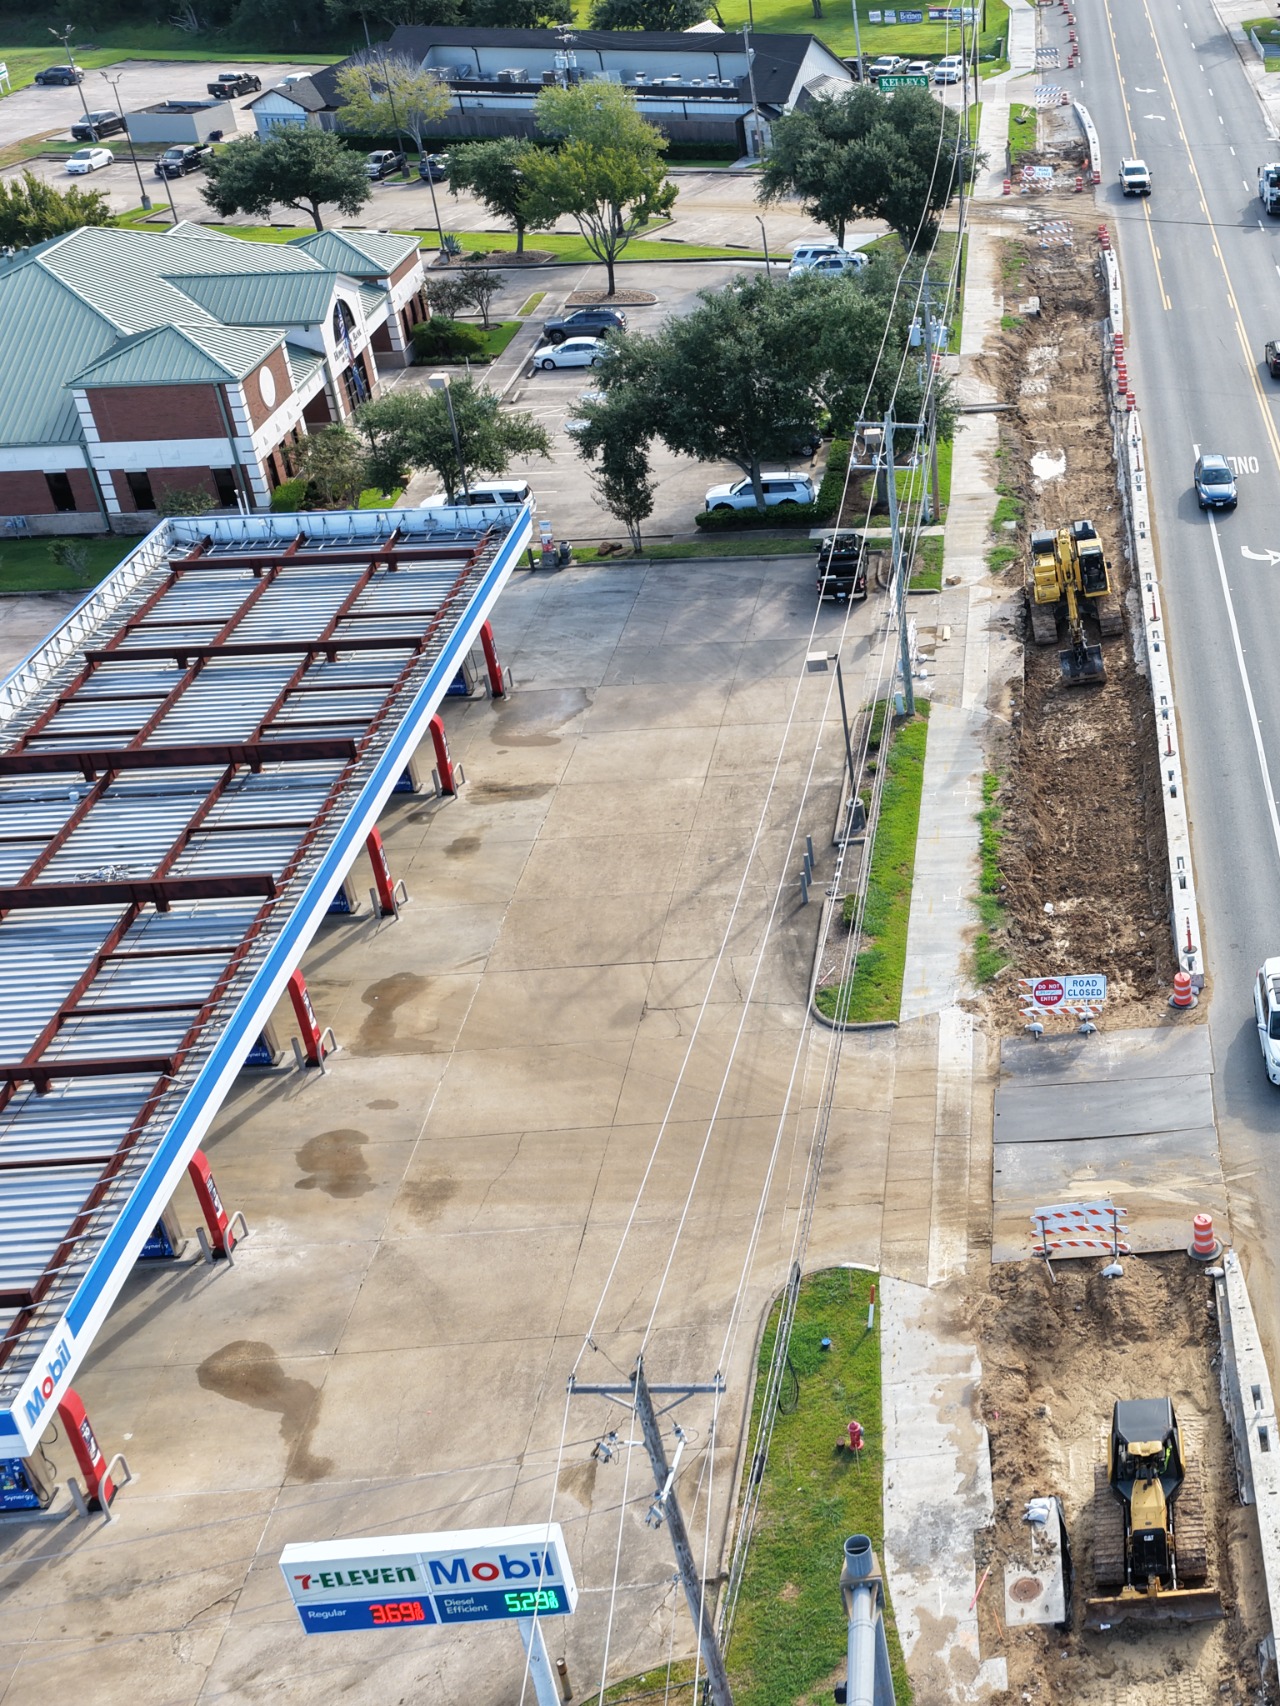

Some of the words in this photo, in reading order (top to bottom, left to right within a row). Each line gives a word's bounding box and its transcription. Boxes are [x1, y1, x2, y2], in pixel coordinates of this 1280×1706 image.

[1226, 455, 1260, 475] ONL
[1072, 979, 1098, 988] ROAD
[1067, 988, 1103, 997] CLOSED
[24, 1338, 72, 1430] Mobil
[428, 1550, 555, 1586] Mobil
[443, 1596, 475, 1607] Diesel
[307, 1608, 347, 1619] Regular
[446, 1604, 489, 1615] Efficient
